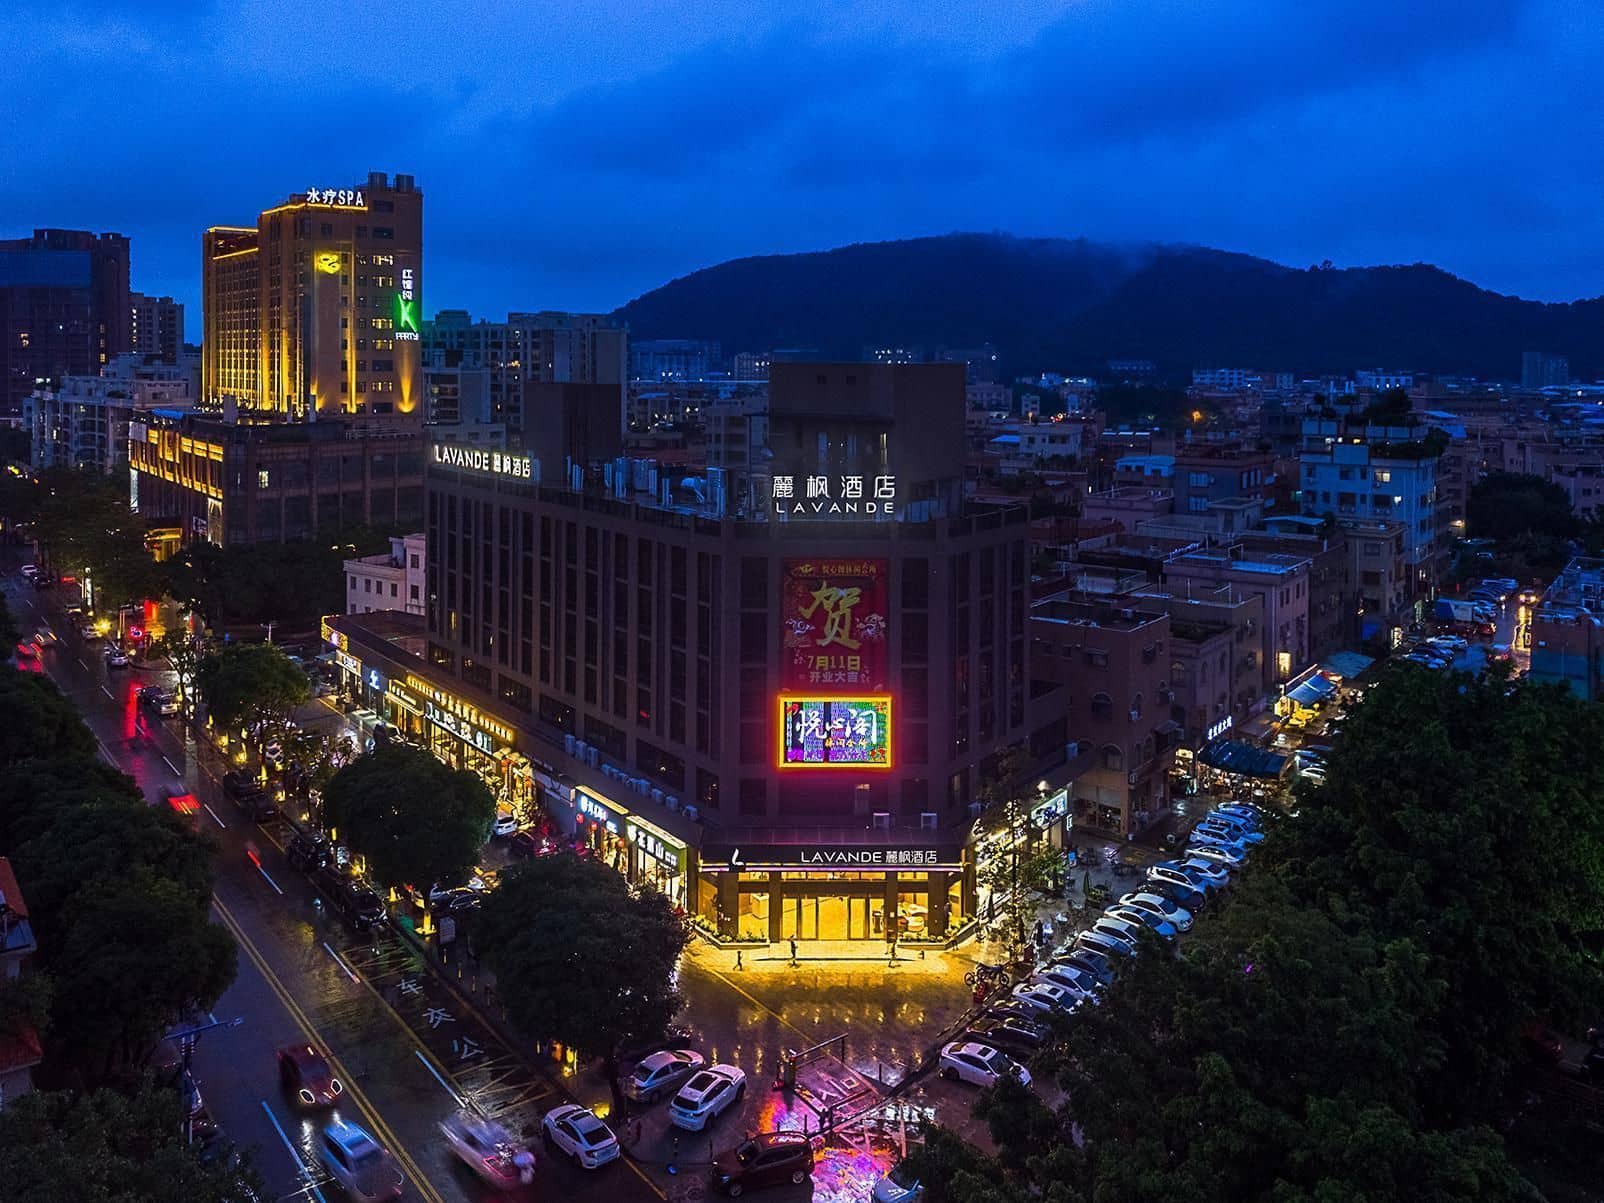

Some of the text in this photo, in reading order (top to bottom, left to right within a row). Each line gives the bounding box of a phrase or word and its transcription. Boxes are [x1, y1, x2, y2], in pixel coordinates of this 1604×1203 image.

[395, 332, 420, 341] PARTY
[434, 445, 489, 471] LAVANDE
[775, 502, 894, 513] LAVANDE
[798, 580, 863, 650] 贺
[807, 655, 861, 672] 7月11日
[801, 851, 882, 864] LAVANDE
